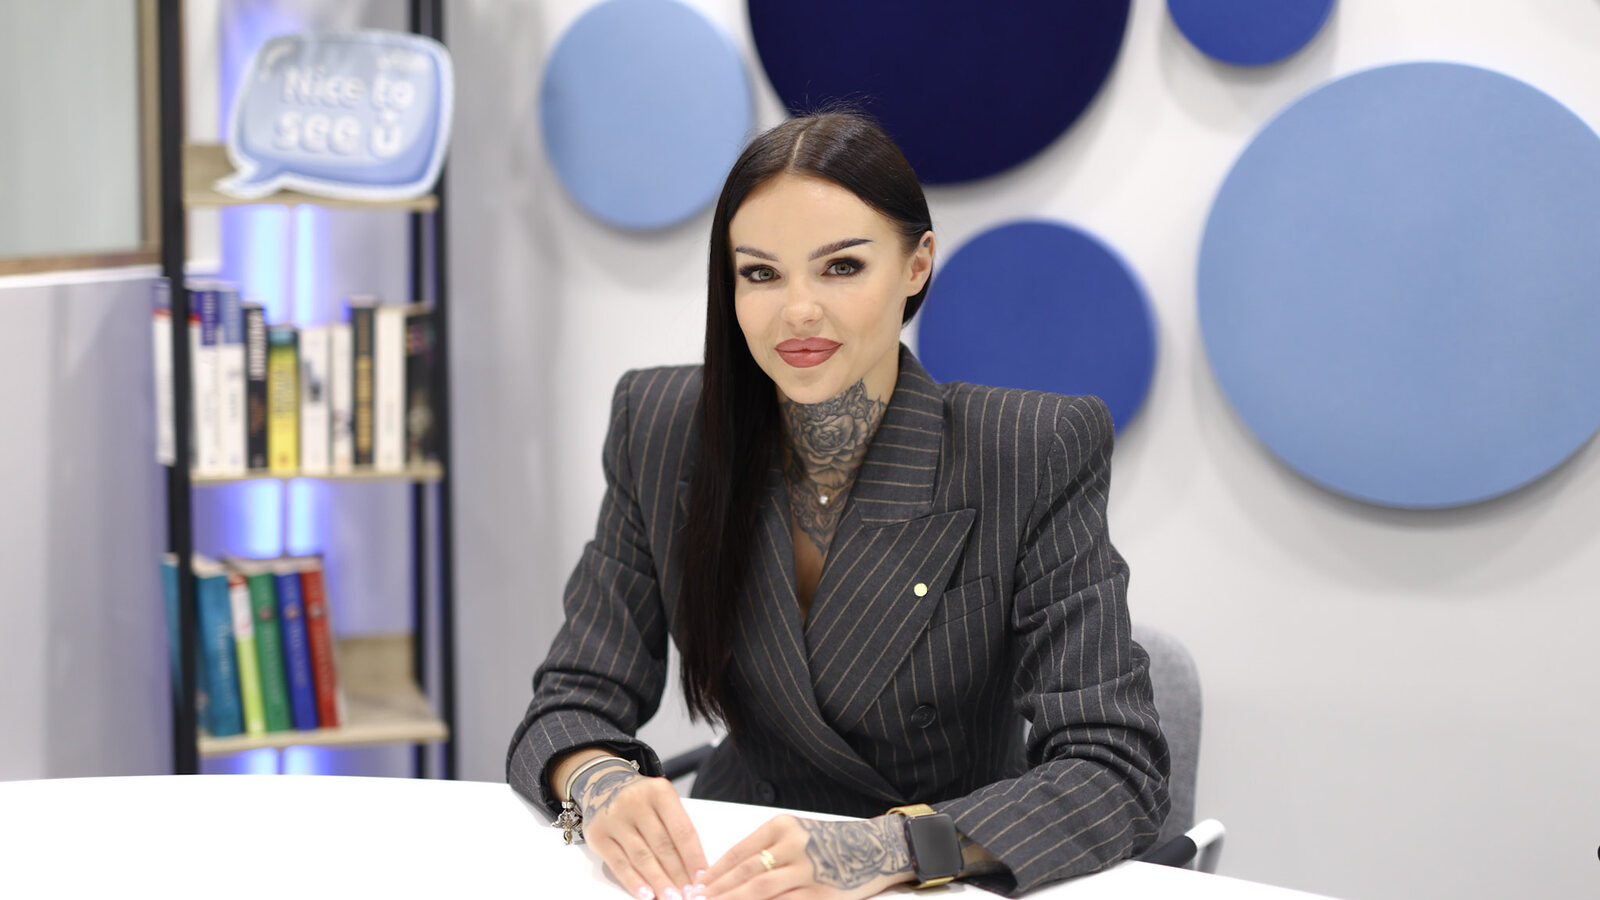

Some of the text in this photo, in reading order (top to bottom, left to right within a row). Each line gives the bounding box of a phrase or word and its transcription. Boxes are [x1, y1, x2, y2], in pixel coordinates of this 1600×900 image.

[283, 64, 414, 108] Nice to
[277, 111, 361, 151] see
